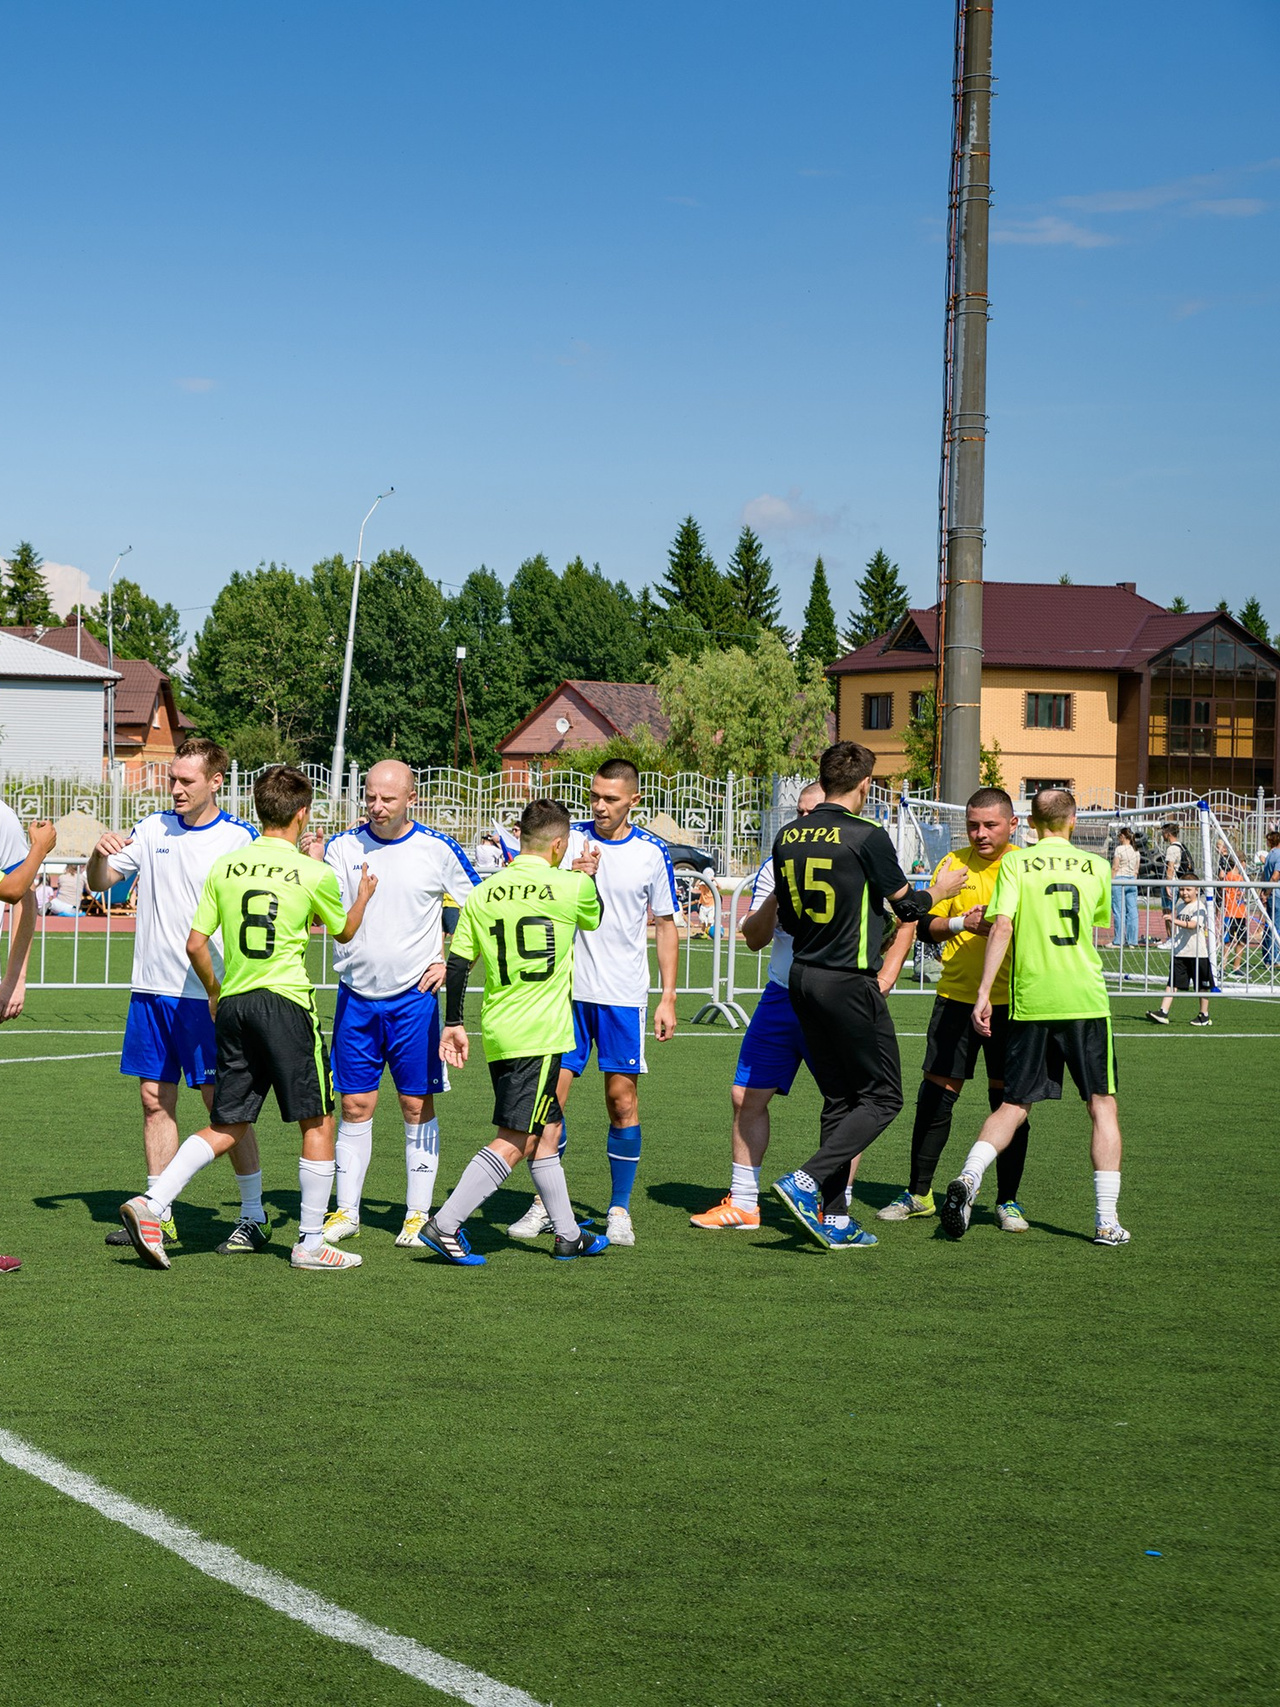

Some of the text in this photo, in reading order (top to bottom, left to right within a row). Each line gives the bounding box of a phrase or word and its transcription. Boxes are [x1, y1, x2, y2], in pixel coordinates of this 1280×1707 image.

[781, 827, 841, 846] ЮГРА
[225, 862, 301, 886] ЮГРА
[1021, 857, 1095, 876] ЮГРА
[486, 884, 556, 903] ЮГРА
[780, 857, 836, 924] 15
[239, 889, 278, 959] 8
[1044, 883, 1080, 946] 3
[489, 916, 555, 986] 19
